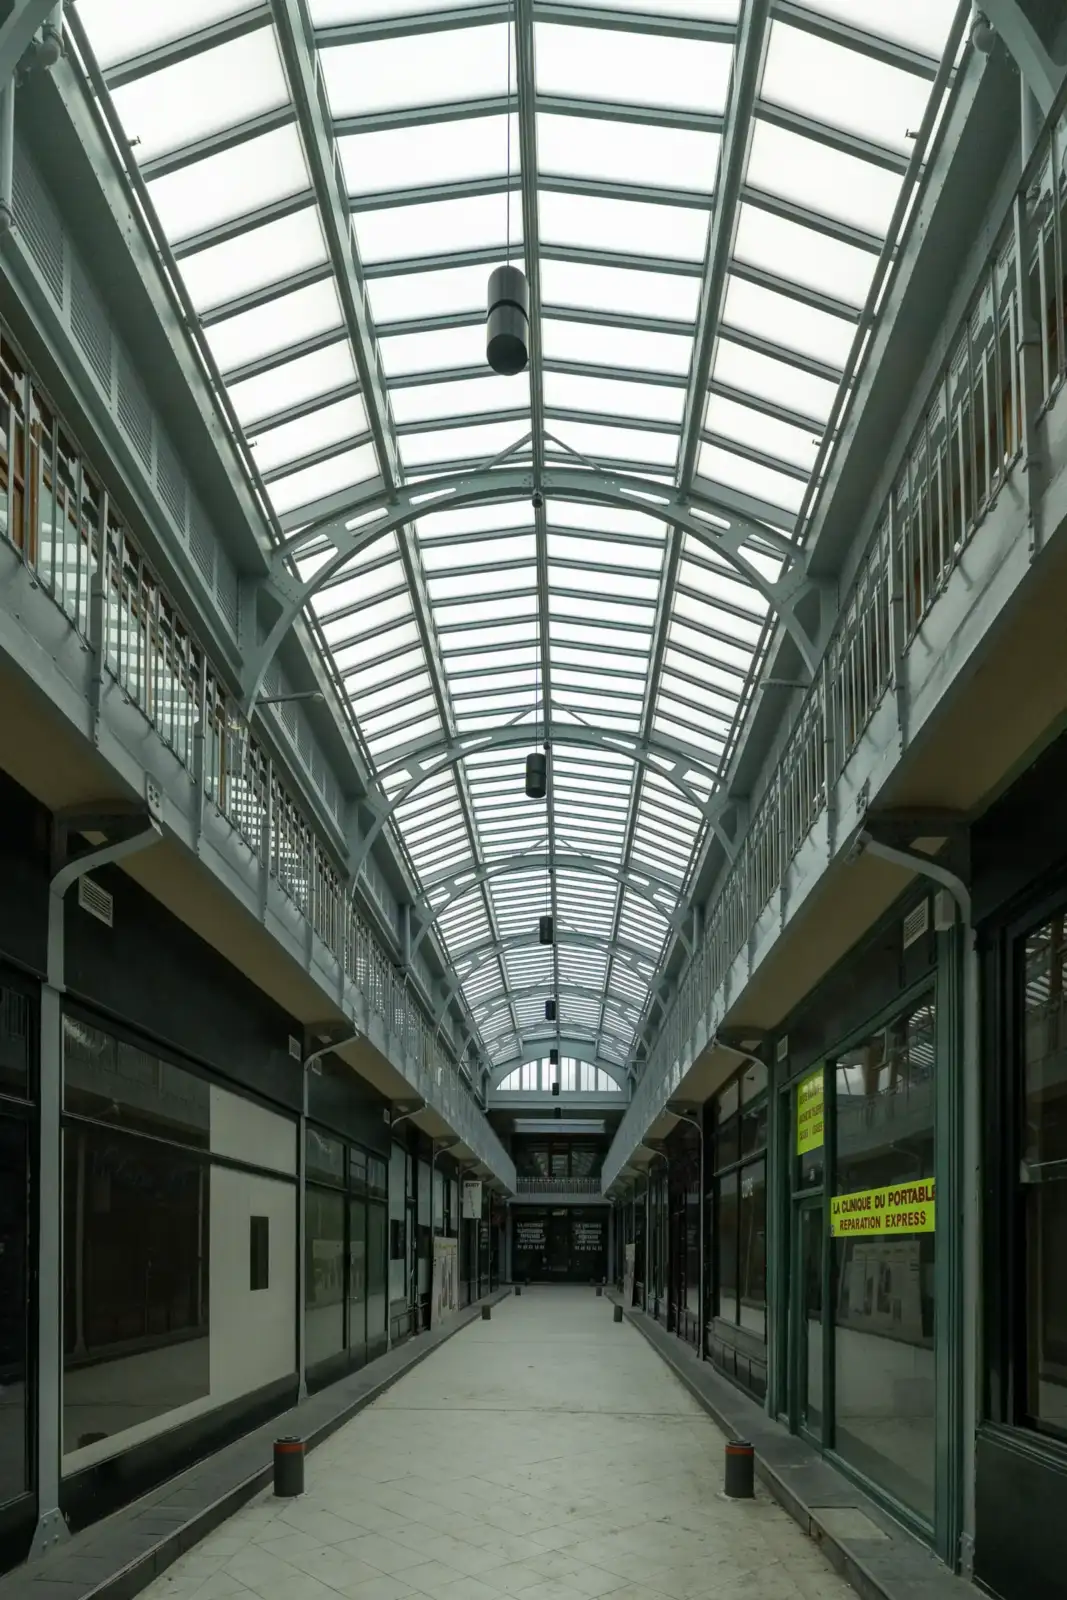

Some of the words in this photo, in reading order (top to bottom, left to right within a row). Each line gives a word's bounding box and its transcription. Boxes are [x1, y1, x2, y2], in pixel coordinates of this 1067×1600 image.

[833, 1202, 840, 1214] LA
[842, 1195, 871, 1213] CLINIQUE
[875, 1194, 885, 1209] DU
[840, 1216, 880, 1231] REPARATION
[885, 1210, 926, 1228] EXPRESS
